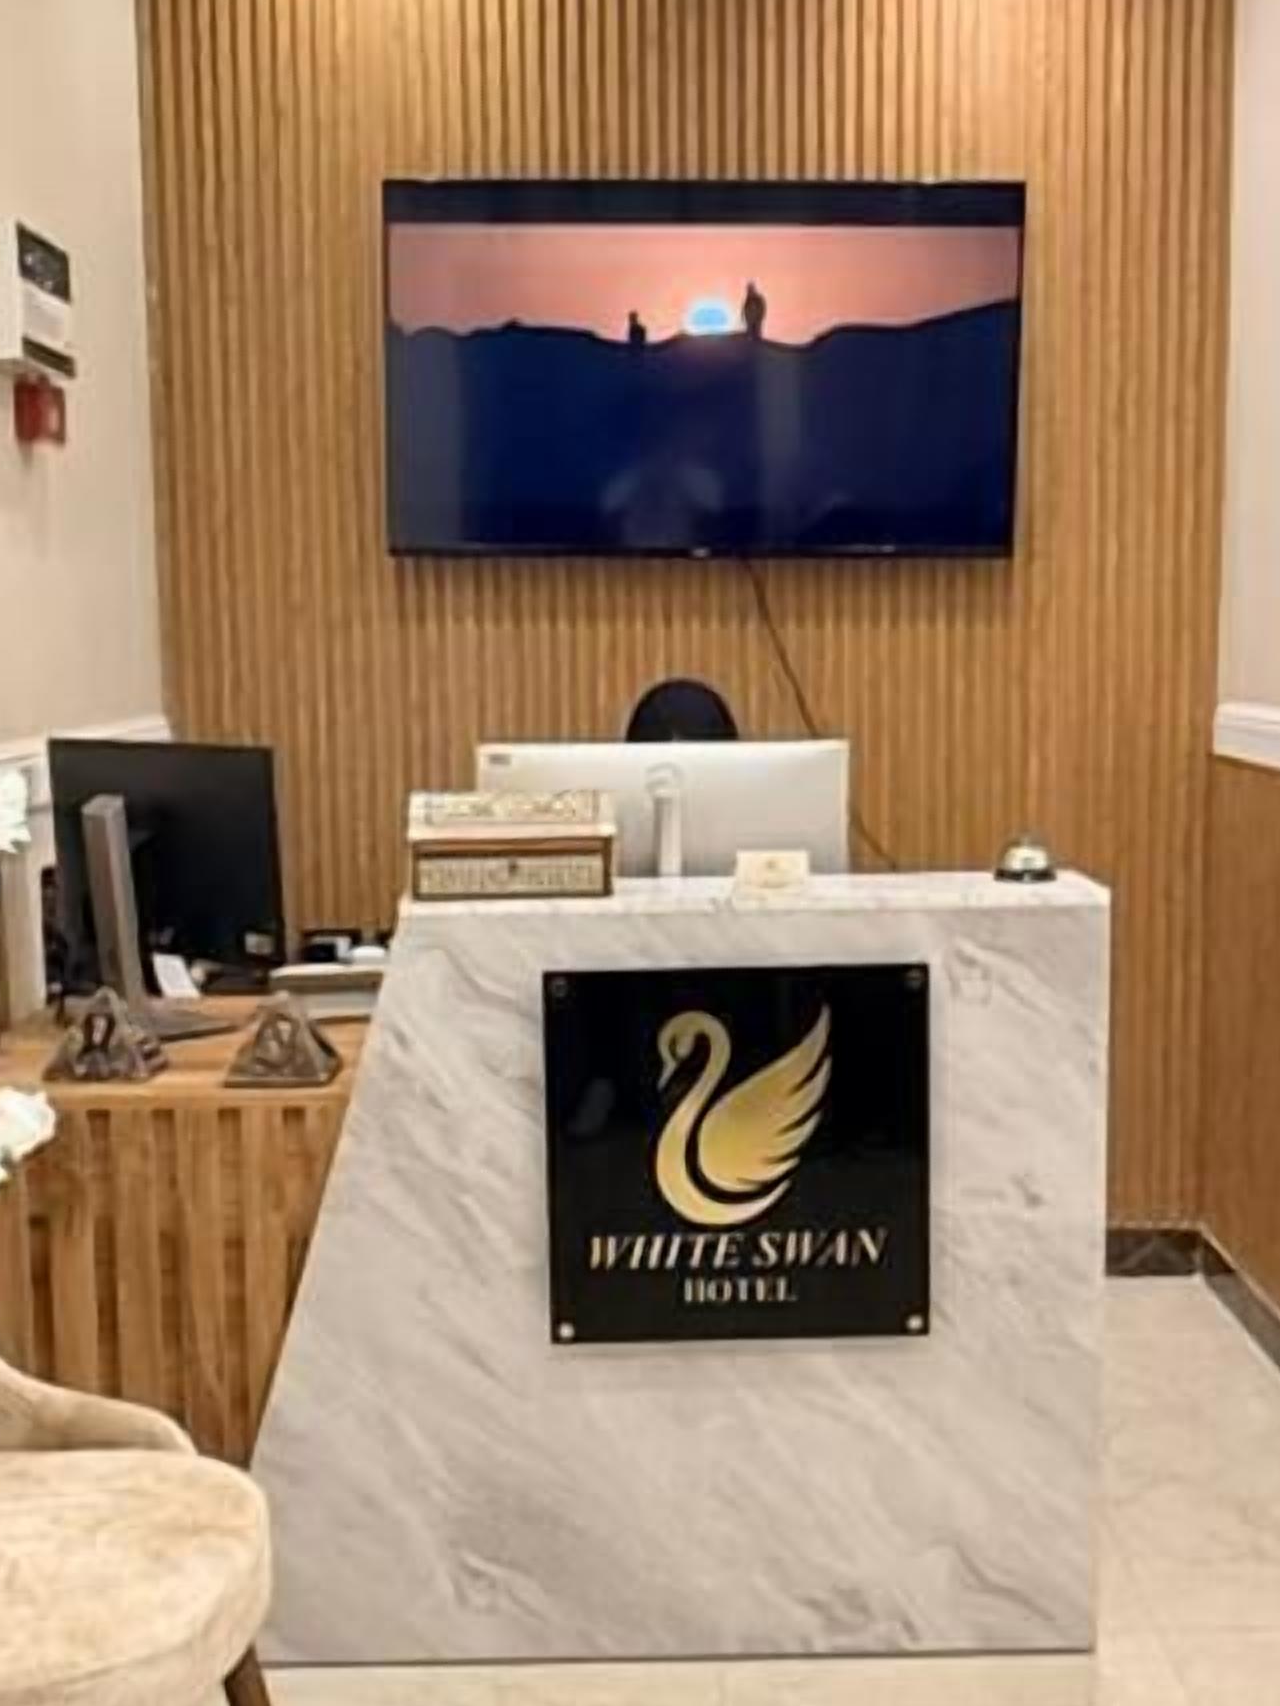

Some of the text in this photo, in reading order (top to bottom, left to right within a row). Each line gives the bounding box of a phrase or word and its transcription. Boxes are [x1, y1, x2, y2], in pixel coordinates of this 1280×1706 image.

[590, 1228, 888, 1269] WHITE SWAN
[683, 1277, 798, 1302] HOTEL
